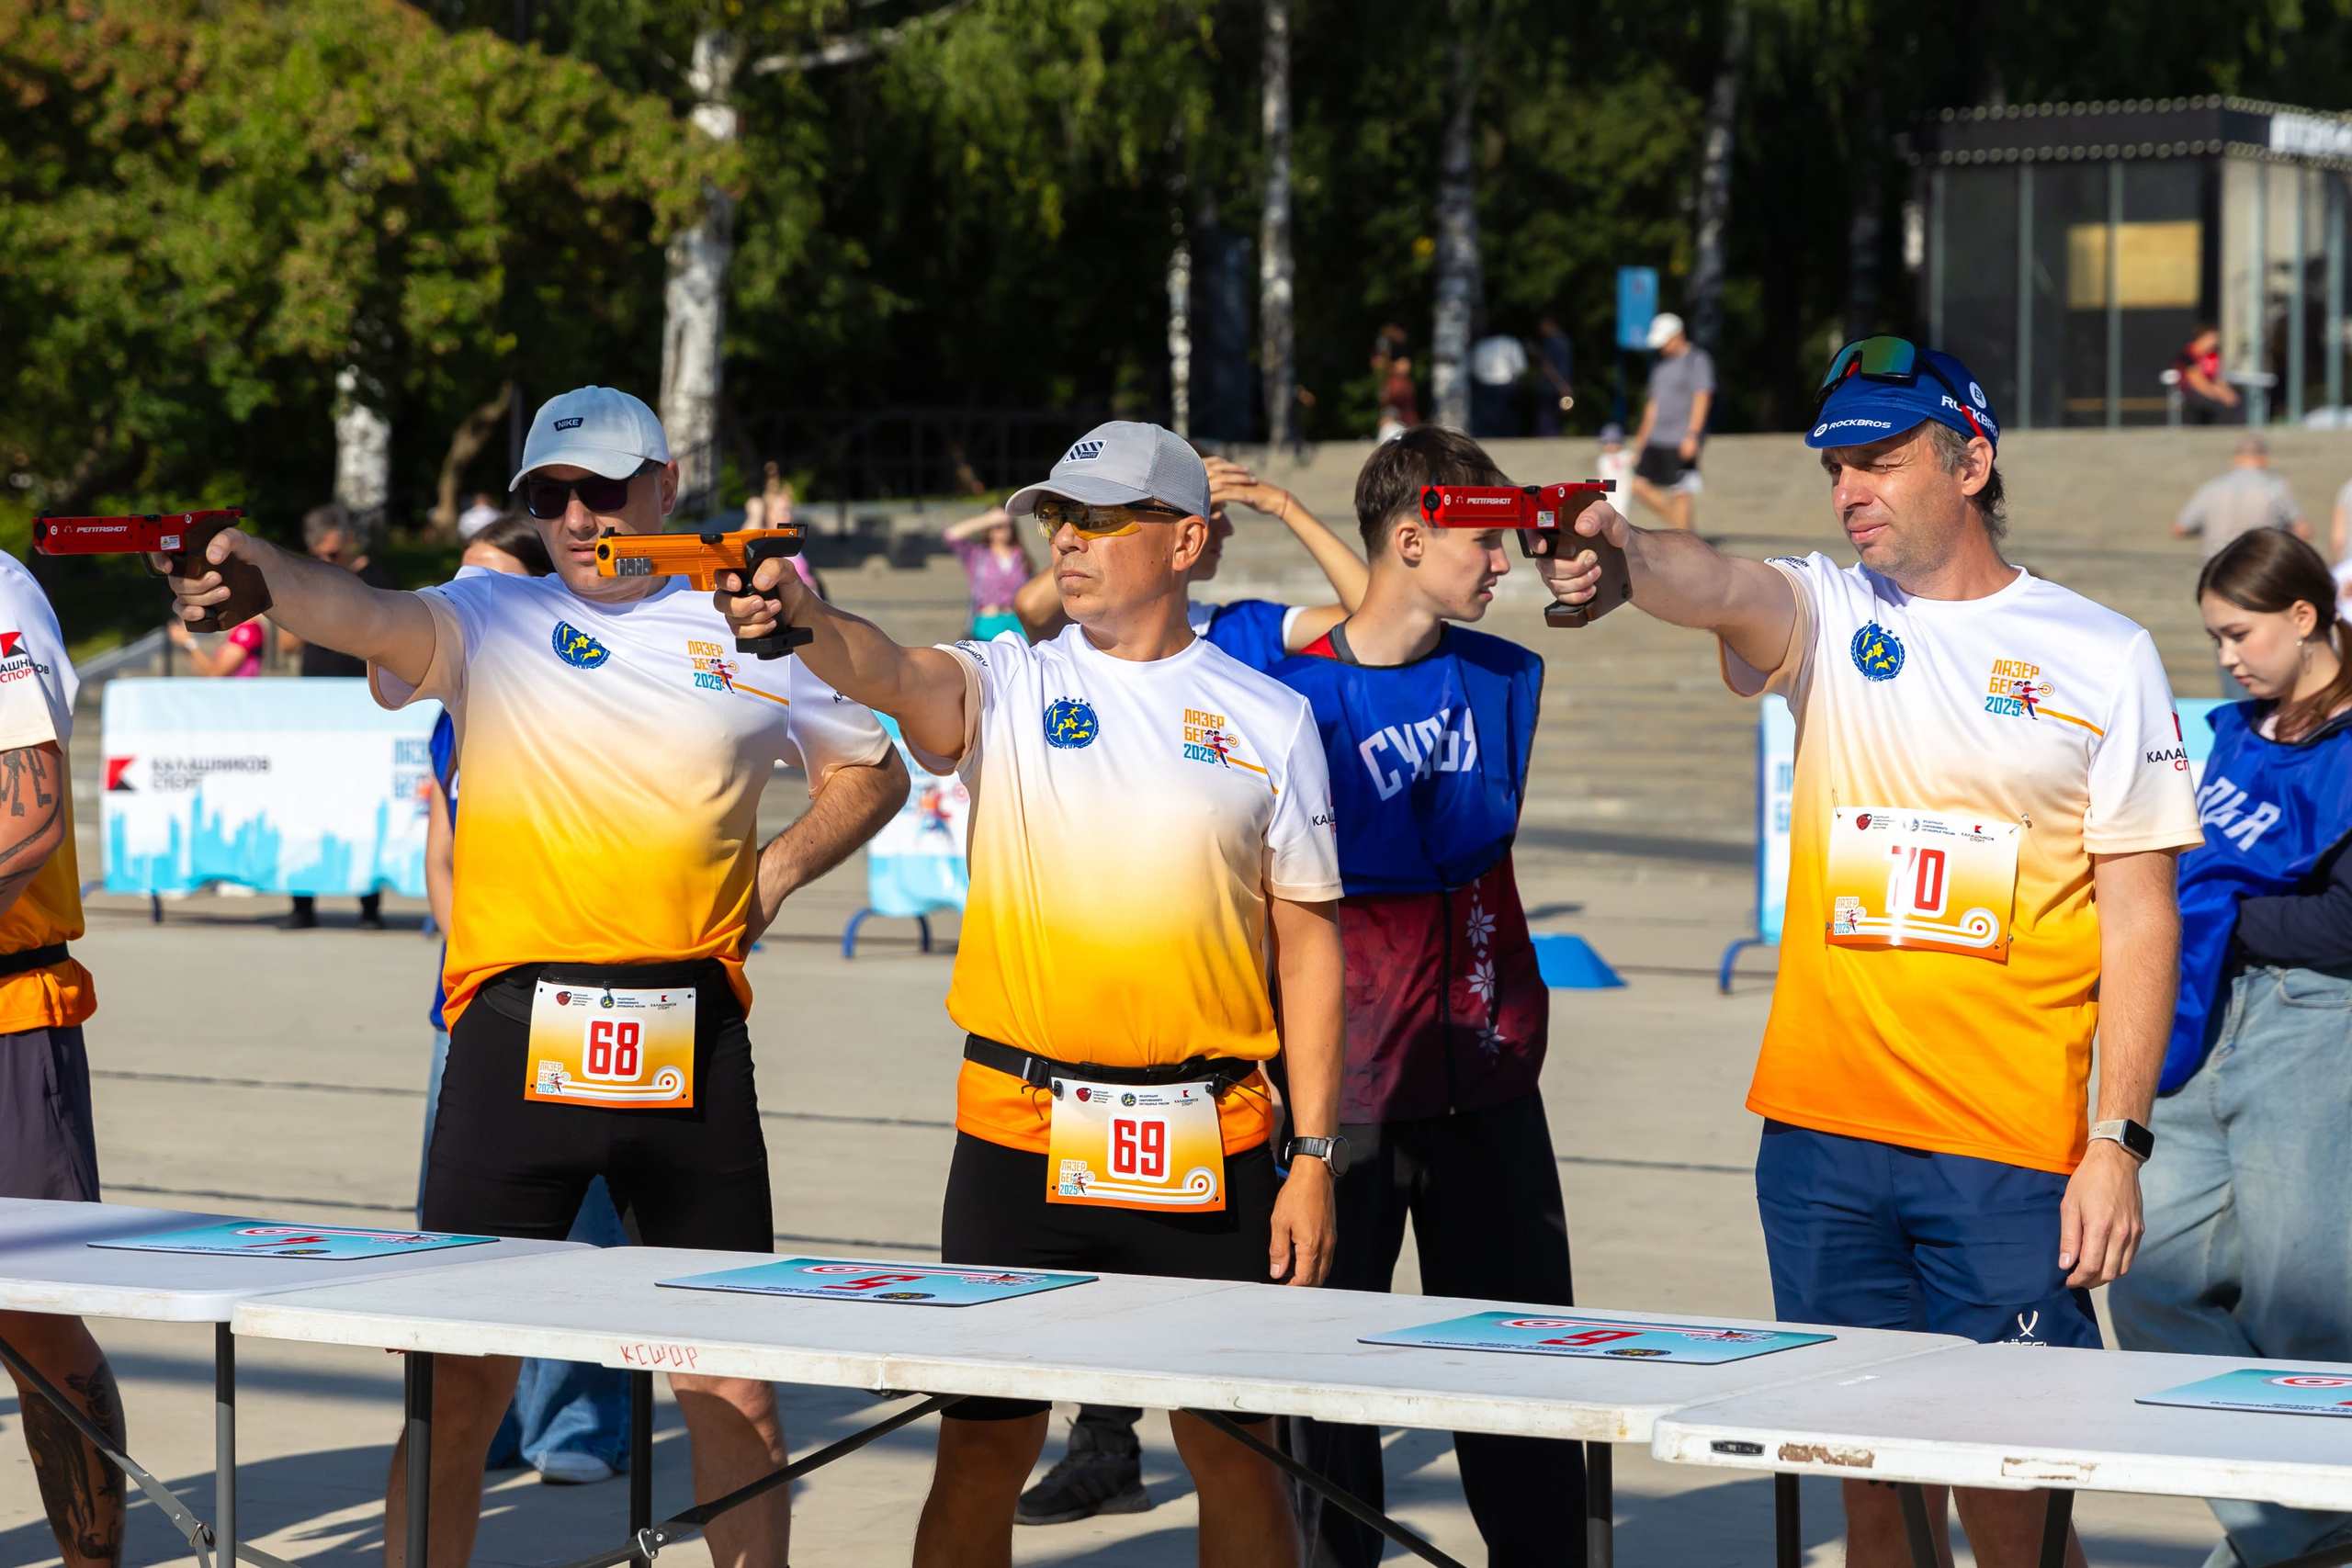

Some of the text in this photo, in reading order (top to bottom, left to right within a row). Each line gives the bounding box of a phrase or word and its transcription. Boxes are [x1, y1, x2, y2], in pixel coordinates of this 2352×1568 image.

[558, 419, 579, 428] NIKE
[1828, 419, 1892, 430] ROCKBROS
[687, 640, 724, 658] ЛАЗЕР
[1991, 659, 2040, 679] ЛАЗЕР
[694, 672, 722, 691] 2025
[1984, 695, 2021, 716] 2025
[1183, 708, 1225, 729] ЛАЗЕР
[1183, 743, 1216, 764] 2025
[1892, 845, 1945, 911] 70
[1837, 898, 1858, 908] ЛАЗЕР
[1835, 922, 1850, 933] 2025
[588, 1021, 639, 1076] 68
[539, 1061, 561, 1072] ЛАЗЕР
[537, 1083, 555, 1093] 2025
[1114, 1119, 1165, 1177] 69
[1061, 1161, 1086, 1171] ЛАЗЕР
[1059, 1184, 1078, 1195] 2025
